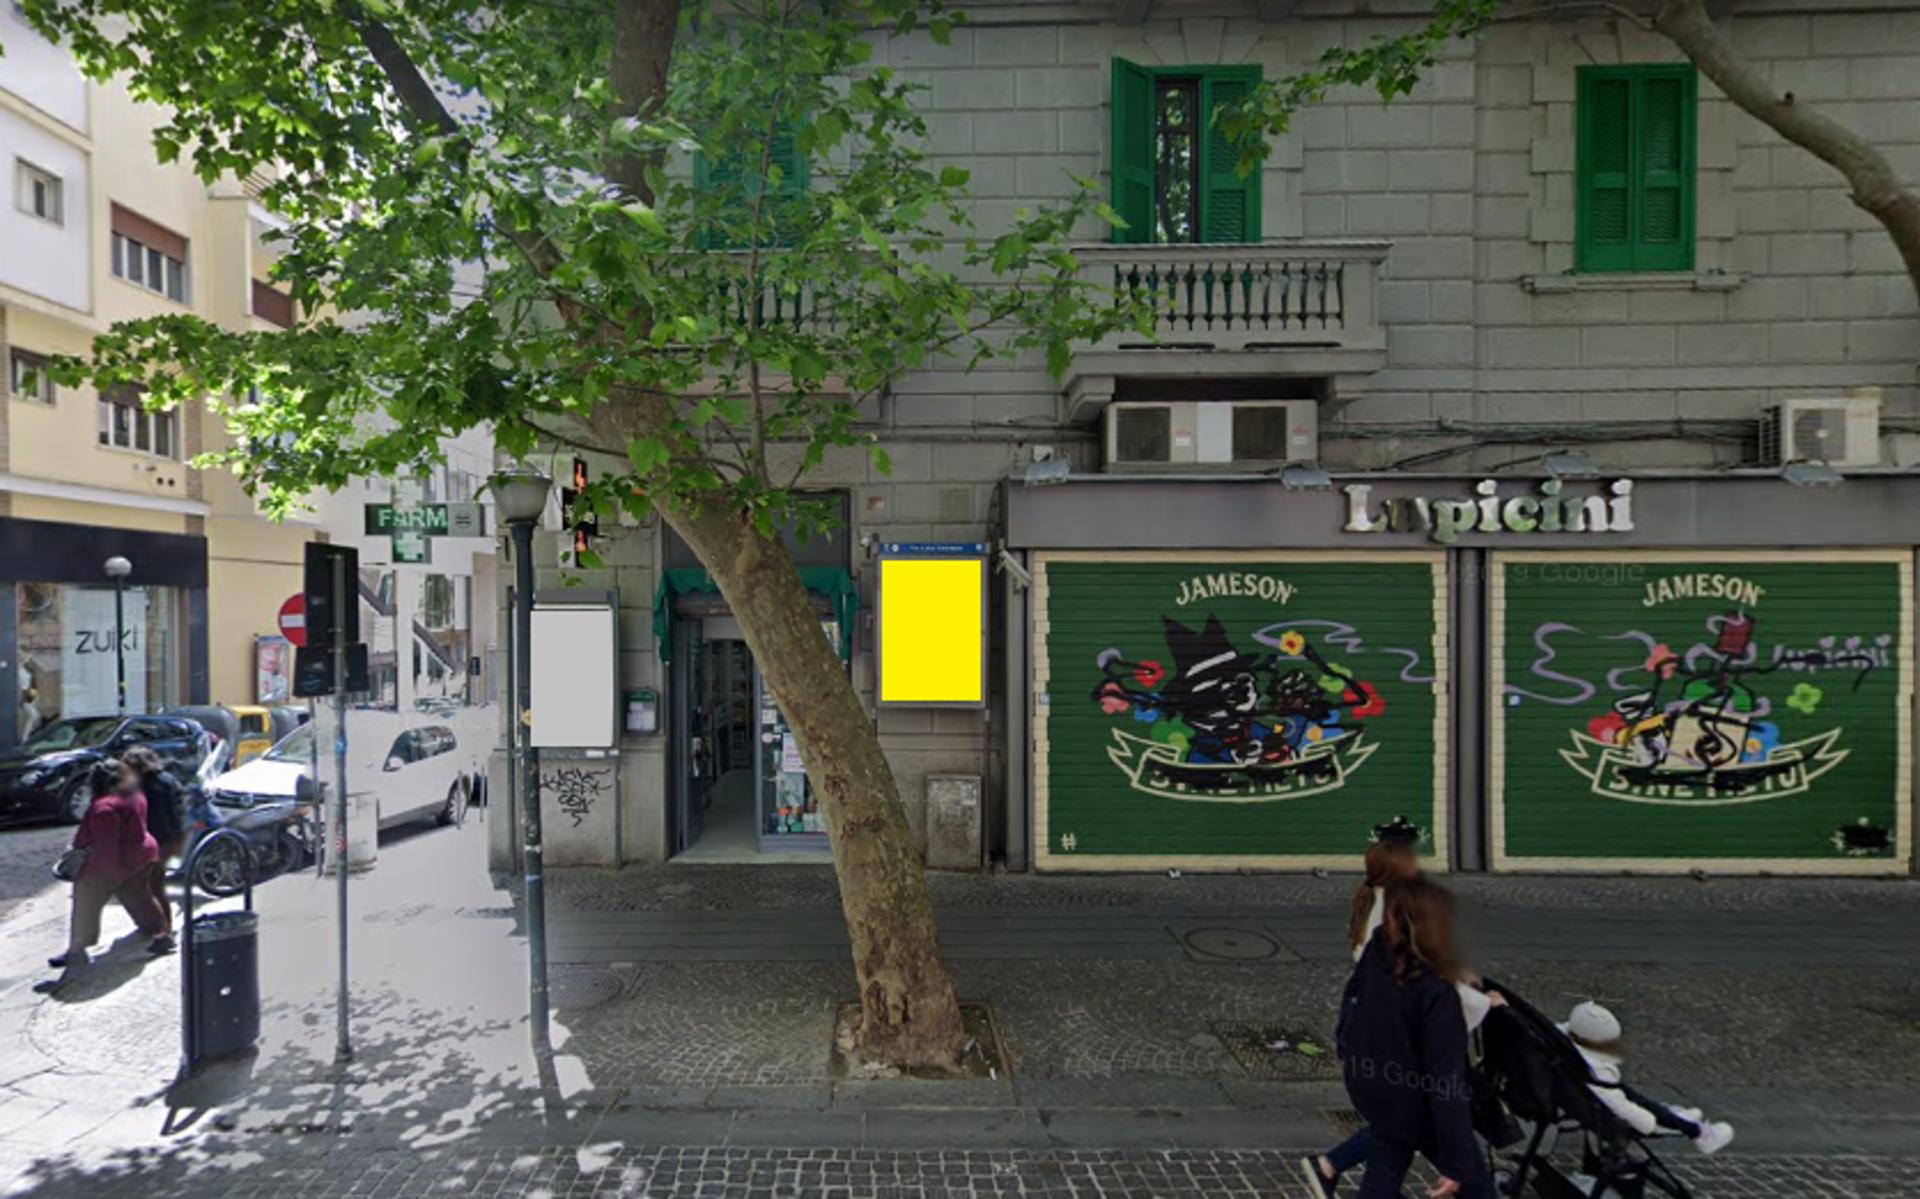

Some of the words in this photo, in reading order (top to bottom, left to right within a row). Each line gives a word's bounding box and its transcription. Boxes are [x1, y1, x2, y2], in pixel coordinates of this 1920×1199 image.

[1344, 479, 1634, 543] Lupicini
[1175, 572, 1292, 606] JAMESON
[1642, 573, 1761, 607] JAMESON
